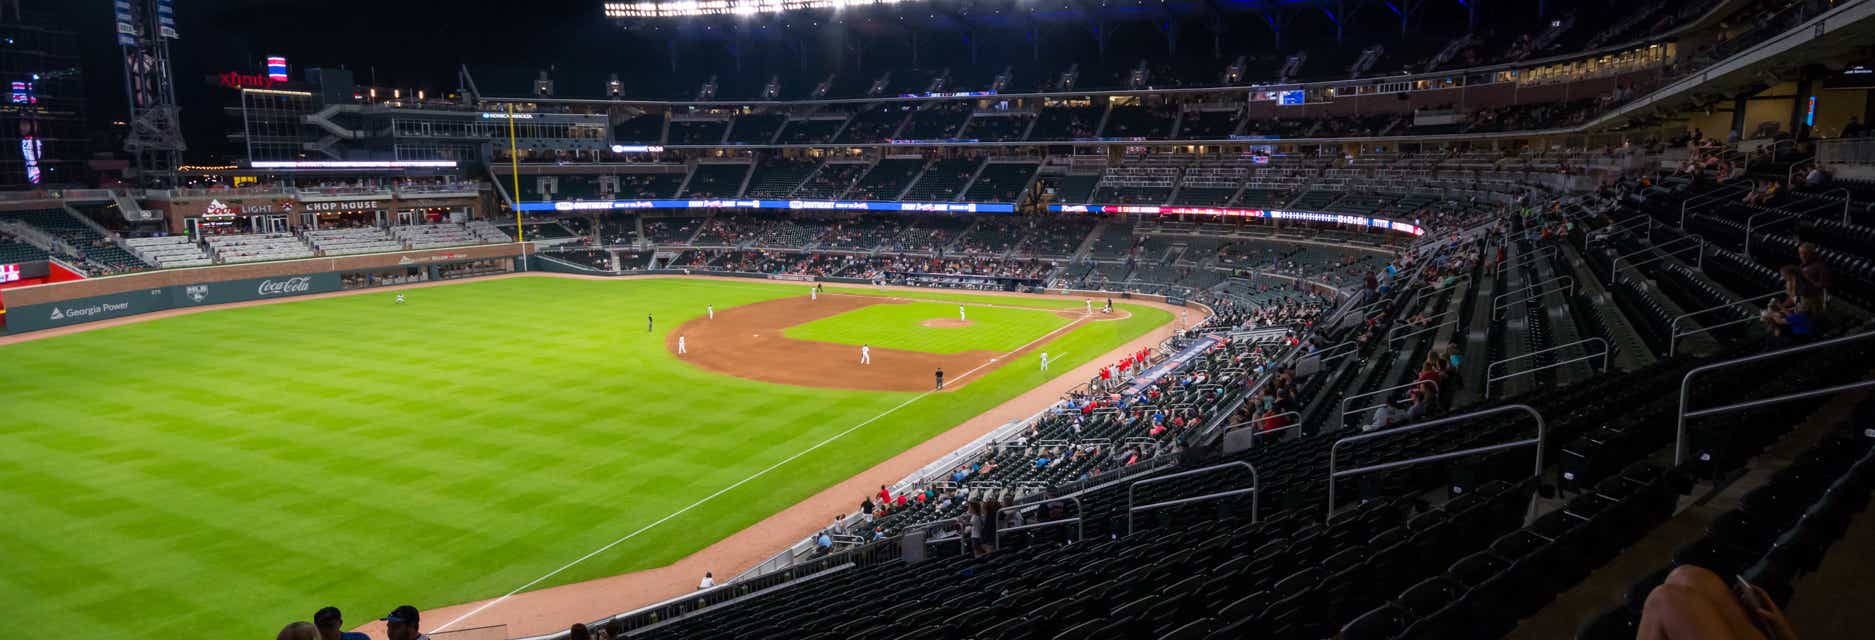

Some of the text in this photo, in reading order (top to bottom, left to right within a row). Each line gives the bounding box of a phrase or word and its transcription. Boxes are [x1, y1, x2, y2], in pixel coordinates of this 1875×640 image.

[241, 205, 272, 213] LIGHT
[306, 201, 377, 210] CHOP HOUSE
[66, 302, 128, 317] Georgia Power
